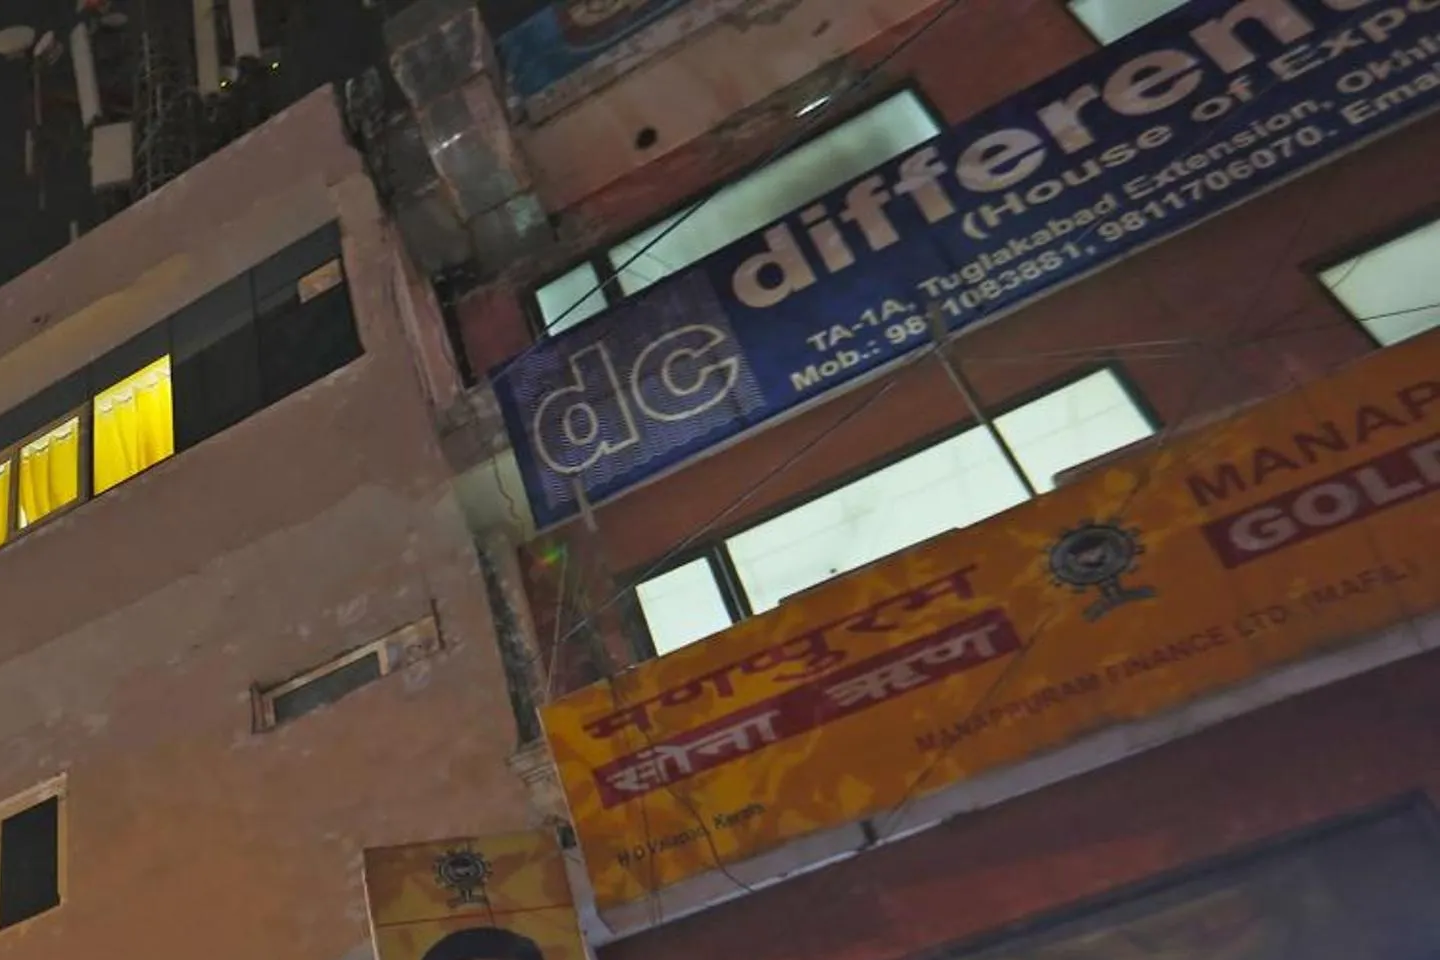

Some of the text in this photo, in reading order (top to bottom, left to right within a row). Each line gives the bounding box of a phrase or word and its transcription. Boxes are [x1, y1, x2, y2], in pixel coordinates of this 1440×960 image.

[732, 0, 1365, 308] differen
[963, 125, 1172, 240] (House
[1191, 74, 1253, 122] of
[918, 193, 1117, 297] Tuglakabad
[534, 324, 738, 474] dc
[1106, 626, 1226, 686] FINANCE
